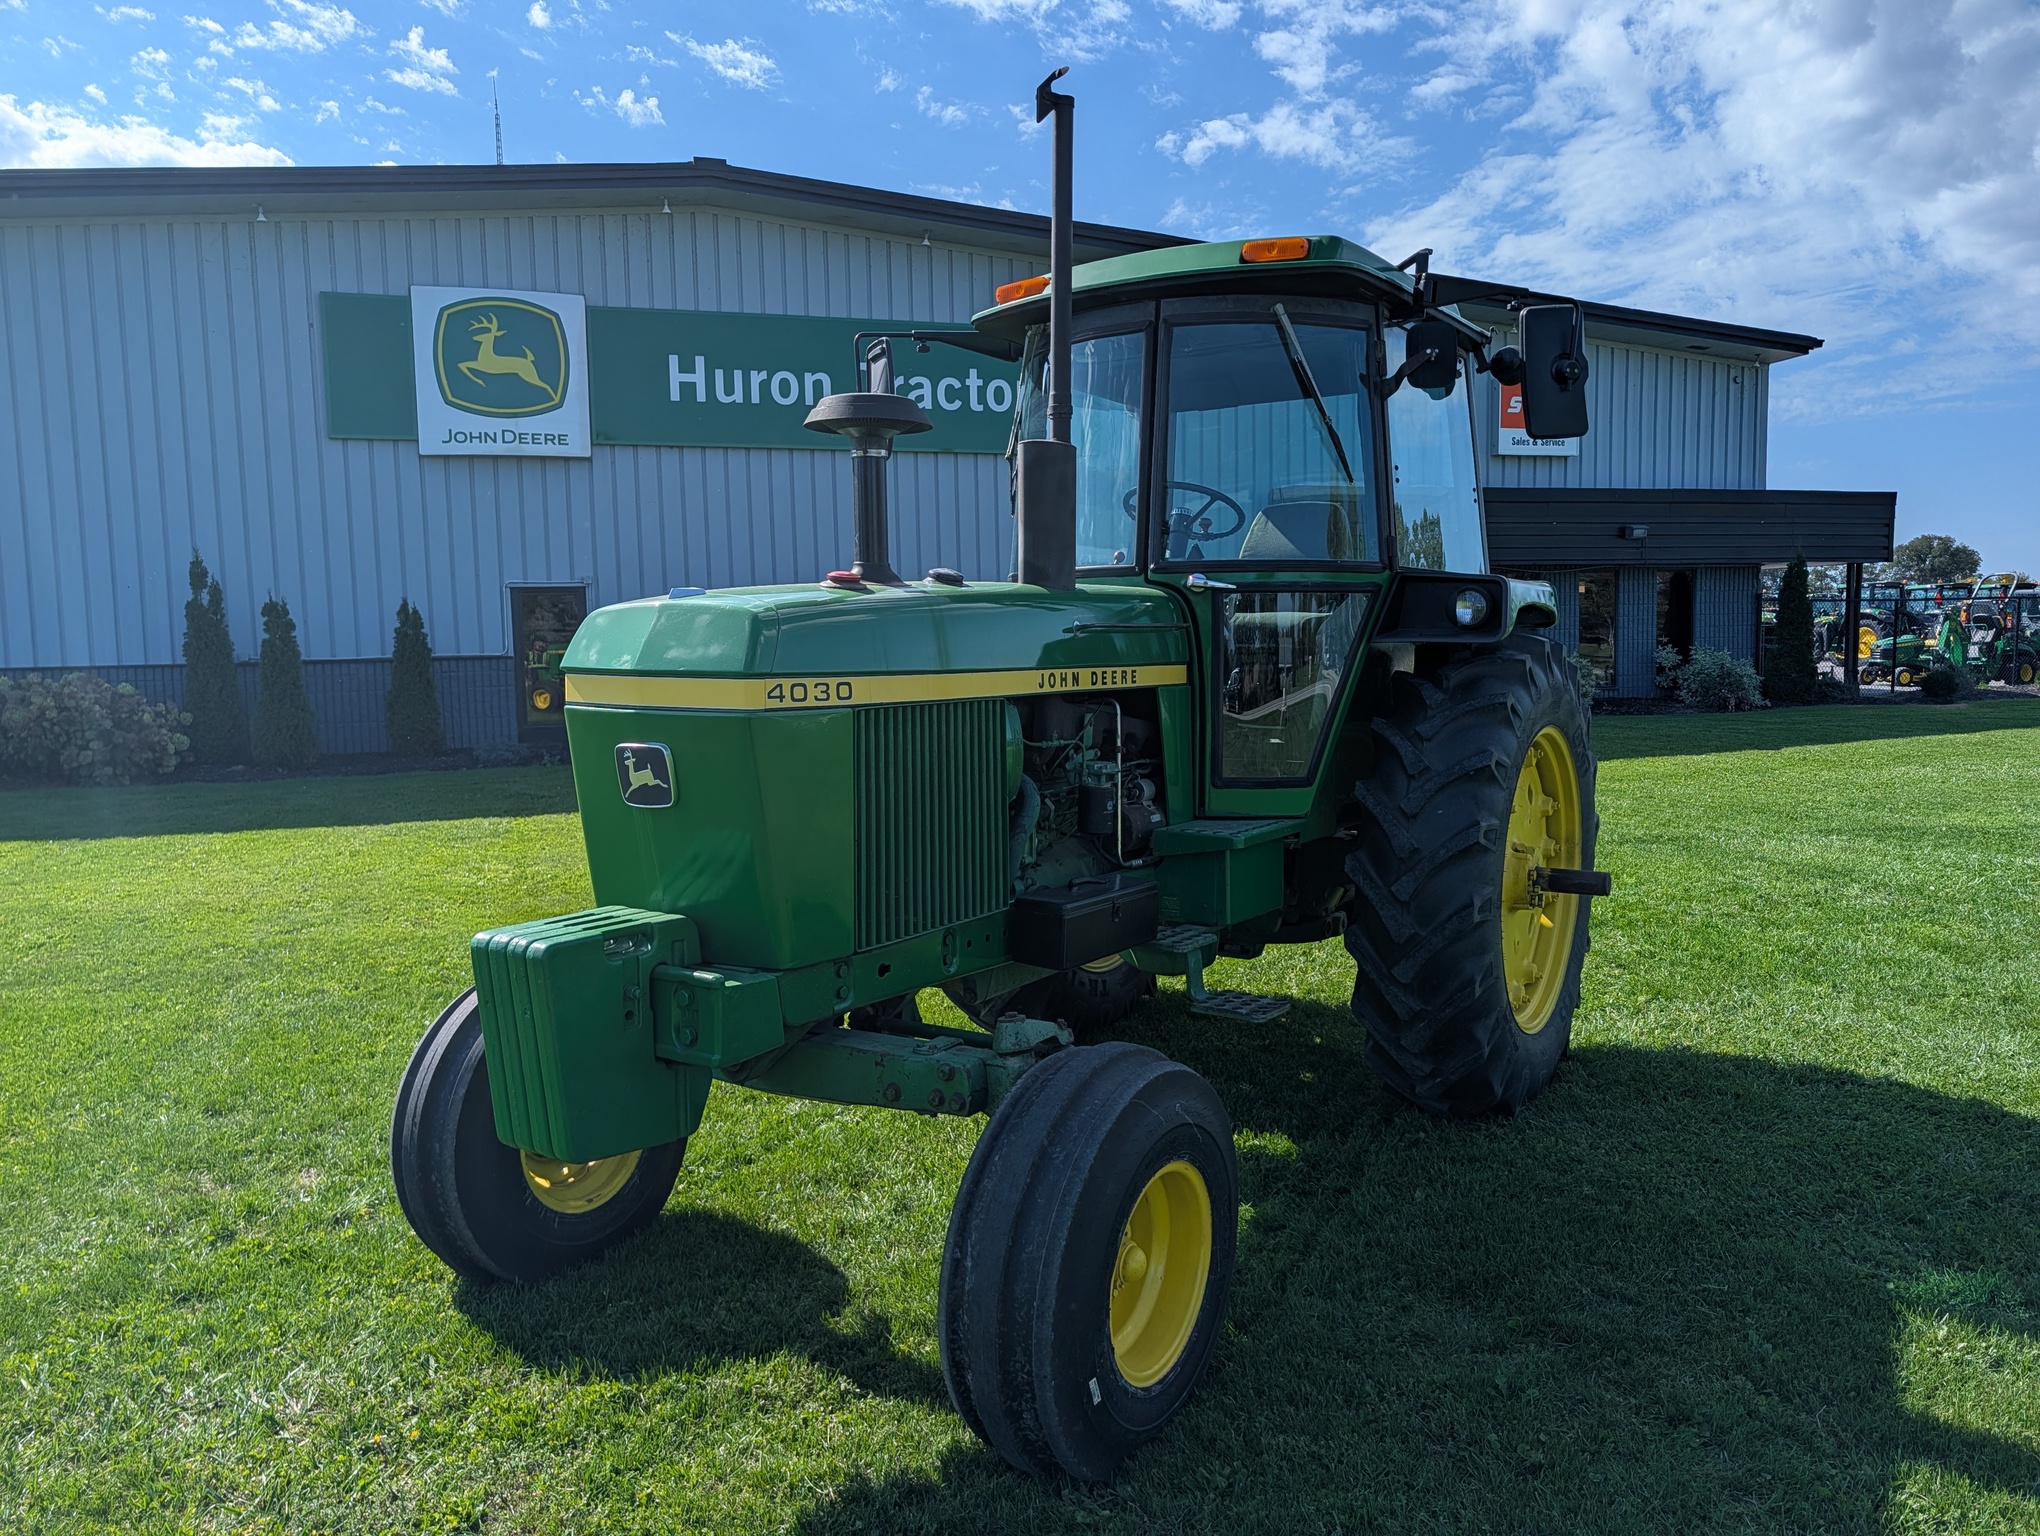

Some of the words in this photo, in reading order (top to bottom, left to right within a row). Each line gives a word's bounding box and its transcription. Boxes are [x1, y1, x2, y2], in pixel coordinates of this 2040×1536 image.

[668, 354, 832, 406] Huron
[441, 428, 497, 444] JOHN
[501, 429, 570, 446] DEERE
[1511, 436, 1530, 446] Sales
[1532, 438, 1539, 447] &
[1540, 438, 1566, 447] Service
[1038, 671, 1080, 689] JOHN
[1090, 669, 1137, 686] DEERE
[767, 681, 853, 703] 4030
